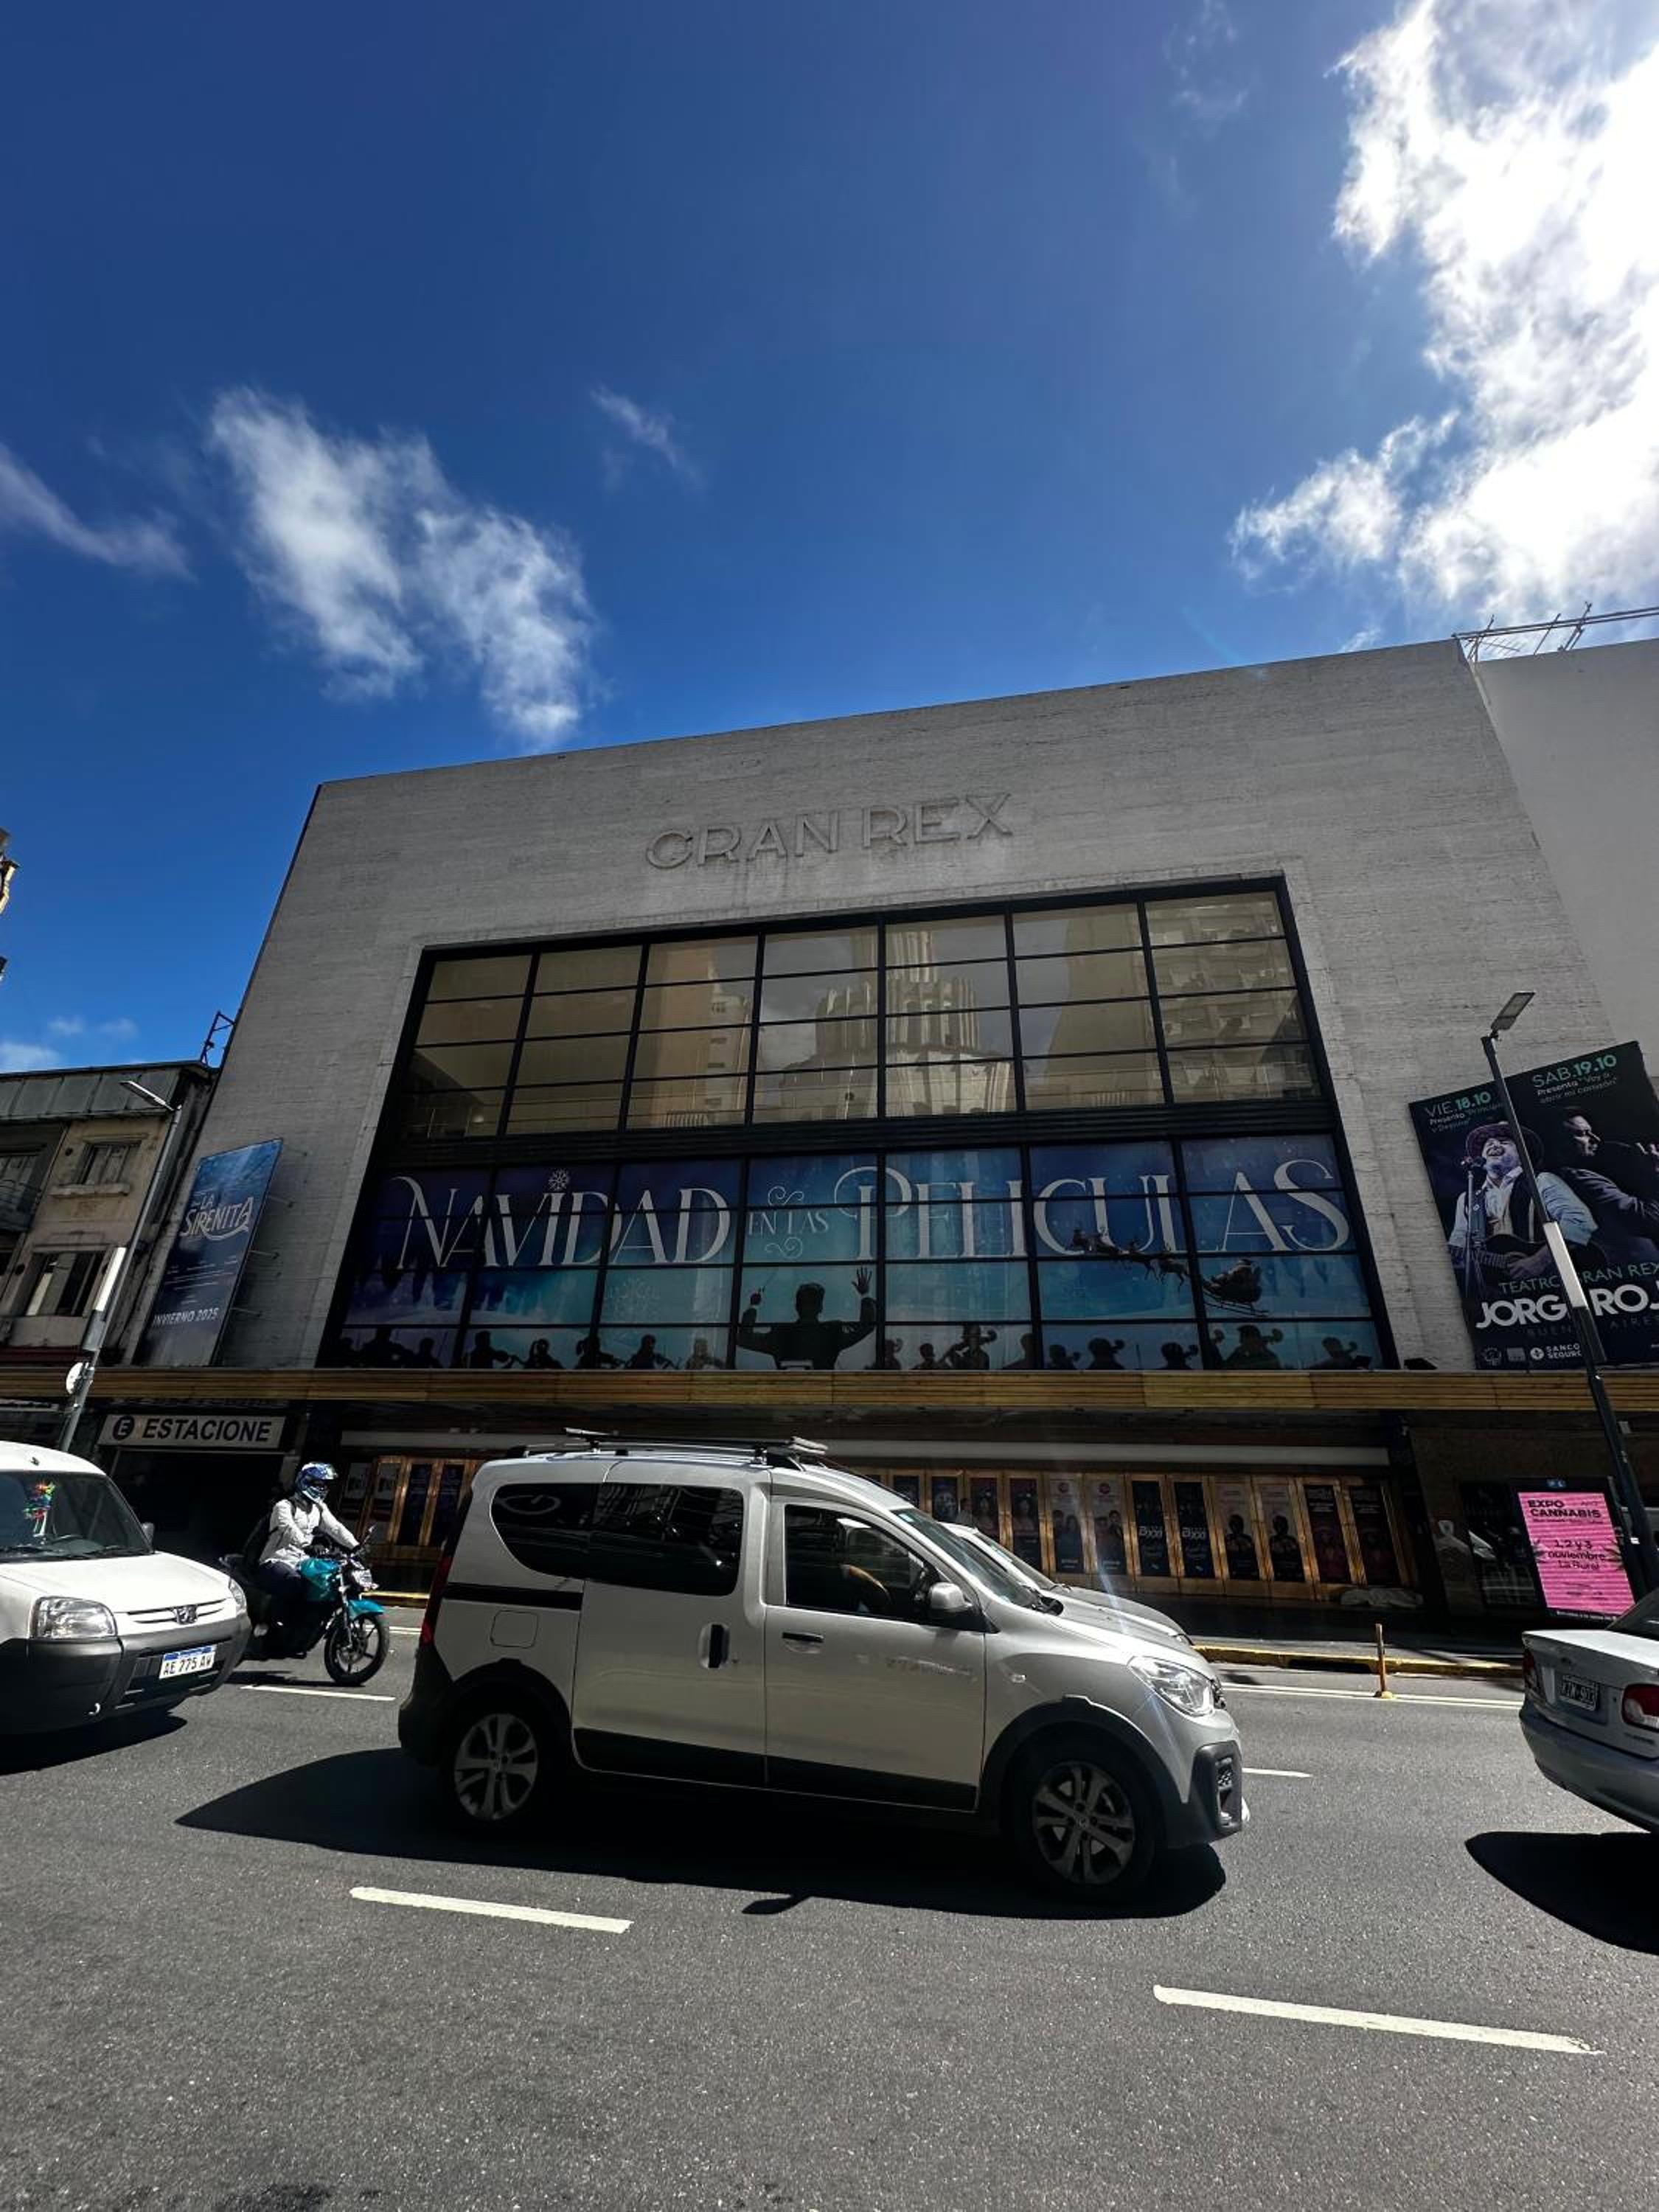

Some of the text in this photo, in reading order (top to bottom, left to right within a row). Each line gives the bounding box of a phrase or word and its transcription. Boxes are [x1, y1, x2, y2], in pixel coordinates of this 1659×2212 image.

[861, 793, 1013, 849] REX
[201, 1194, 215, 1210] LA
[180, 1197, 254, 1241] SIRENITA
[390, 1175, 731, 1269] NAVIDAD
[1582, 1265, 1623, 1284] RAN
[153, 1307, 219, 1326] INVIERNO 2025
[1475, 1295, 1568, 1329] JORG
[142, 1418, 273, 1441] ESTACIONE
[1528, 1500, 1564, 1508] EXPO
[1531, 1509, 1601, 1518] CANNABIS
[1548, 1551, 1605, 1561] noviembre
[178, 1657, 198, 1672] 775
